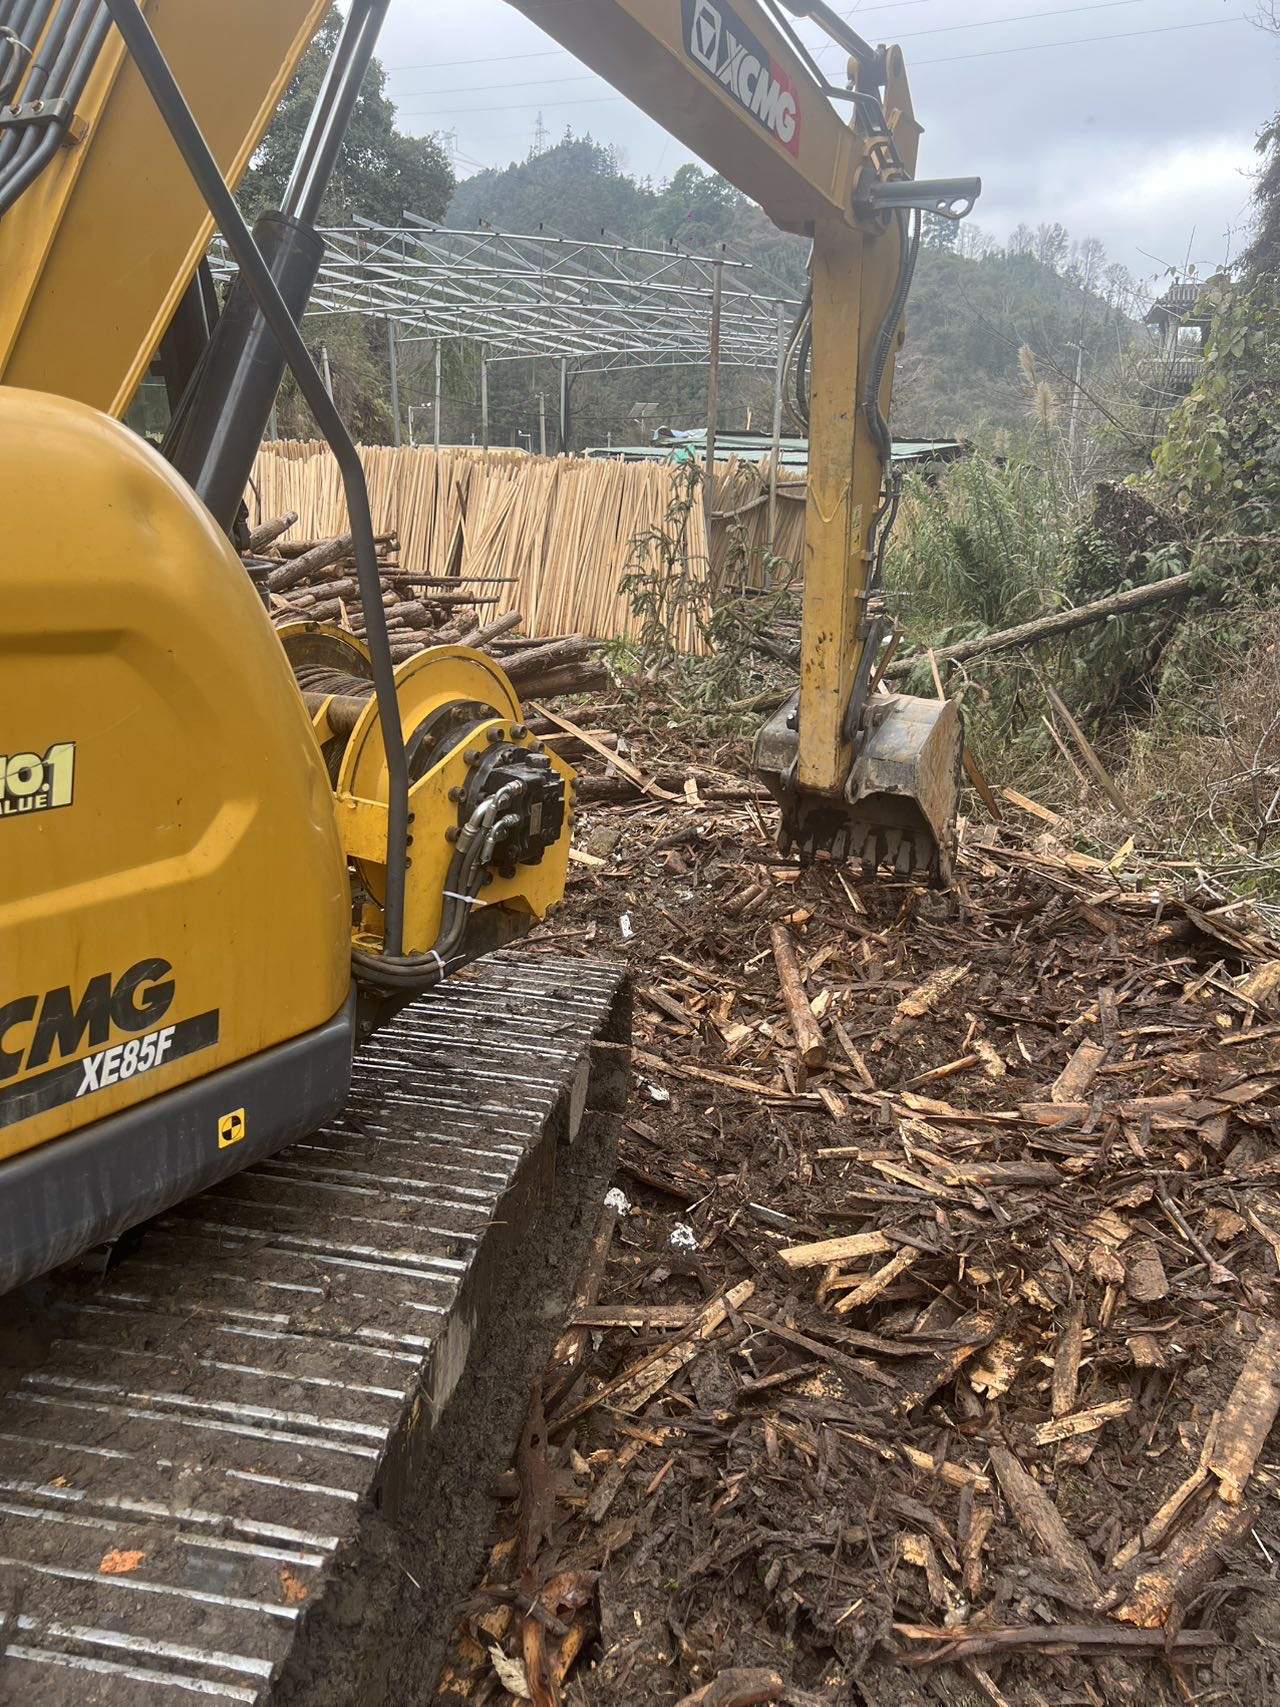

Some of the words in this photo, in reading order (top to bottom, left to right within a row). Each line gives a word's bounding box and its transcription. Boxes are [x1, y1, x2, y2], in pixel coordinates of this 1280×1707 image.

[714, 29, 796, 143] XCMG
[0, 794, 47, 814] LUE
[76, 1026, 176, 1097] XE85F
